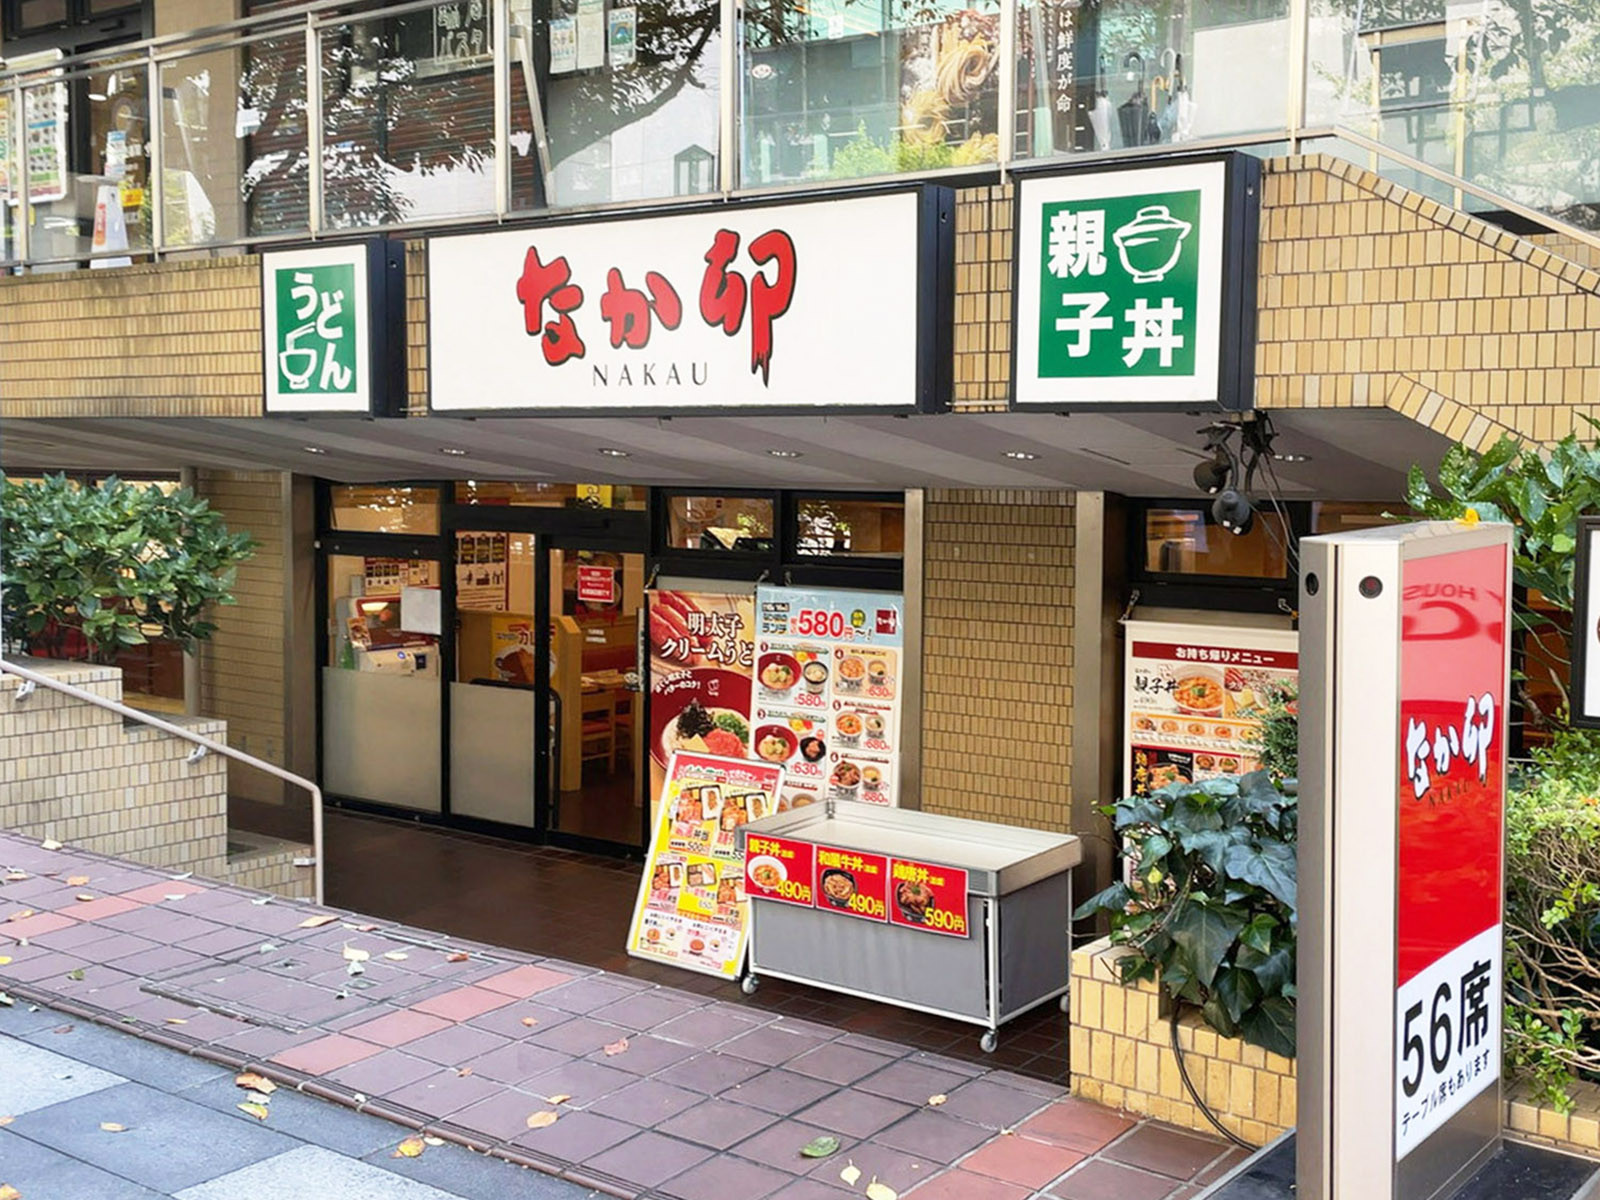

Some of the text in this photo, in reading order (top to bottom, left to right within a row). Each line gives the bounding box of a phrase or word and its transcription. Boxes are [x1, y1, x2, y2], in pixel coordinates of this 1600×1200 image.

[1047, 209, 1108, 279] 親
[290, 272, 353, 390] うどん
[516, 228, 797, 388] なか卯
[592, 361, 709, 387] NAKAU
[660, 637, 754, 666] クリームうど
[687, 611, 744, 638] 明太子
[1175, 647, 1275, 664] お持ち帰りメニュー
[1405, 692, 1496, 801] なか卯
[1401, 958, 1493, 1099] 56席
[1401, 1049, 1491, 1137] テーブル席もあります
